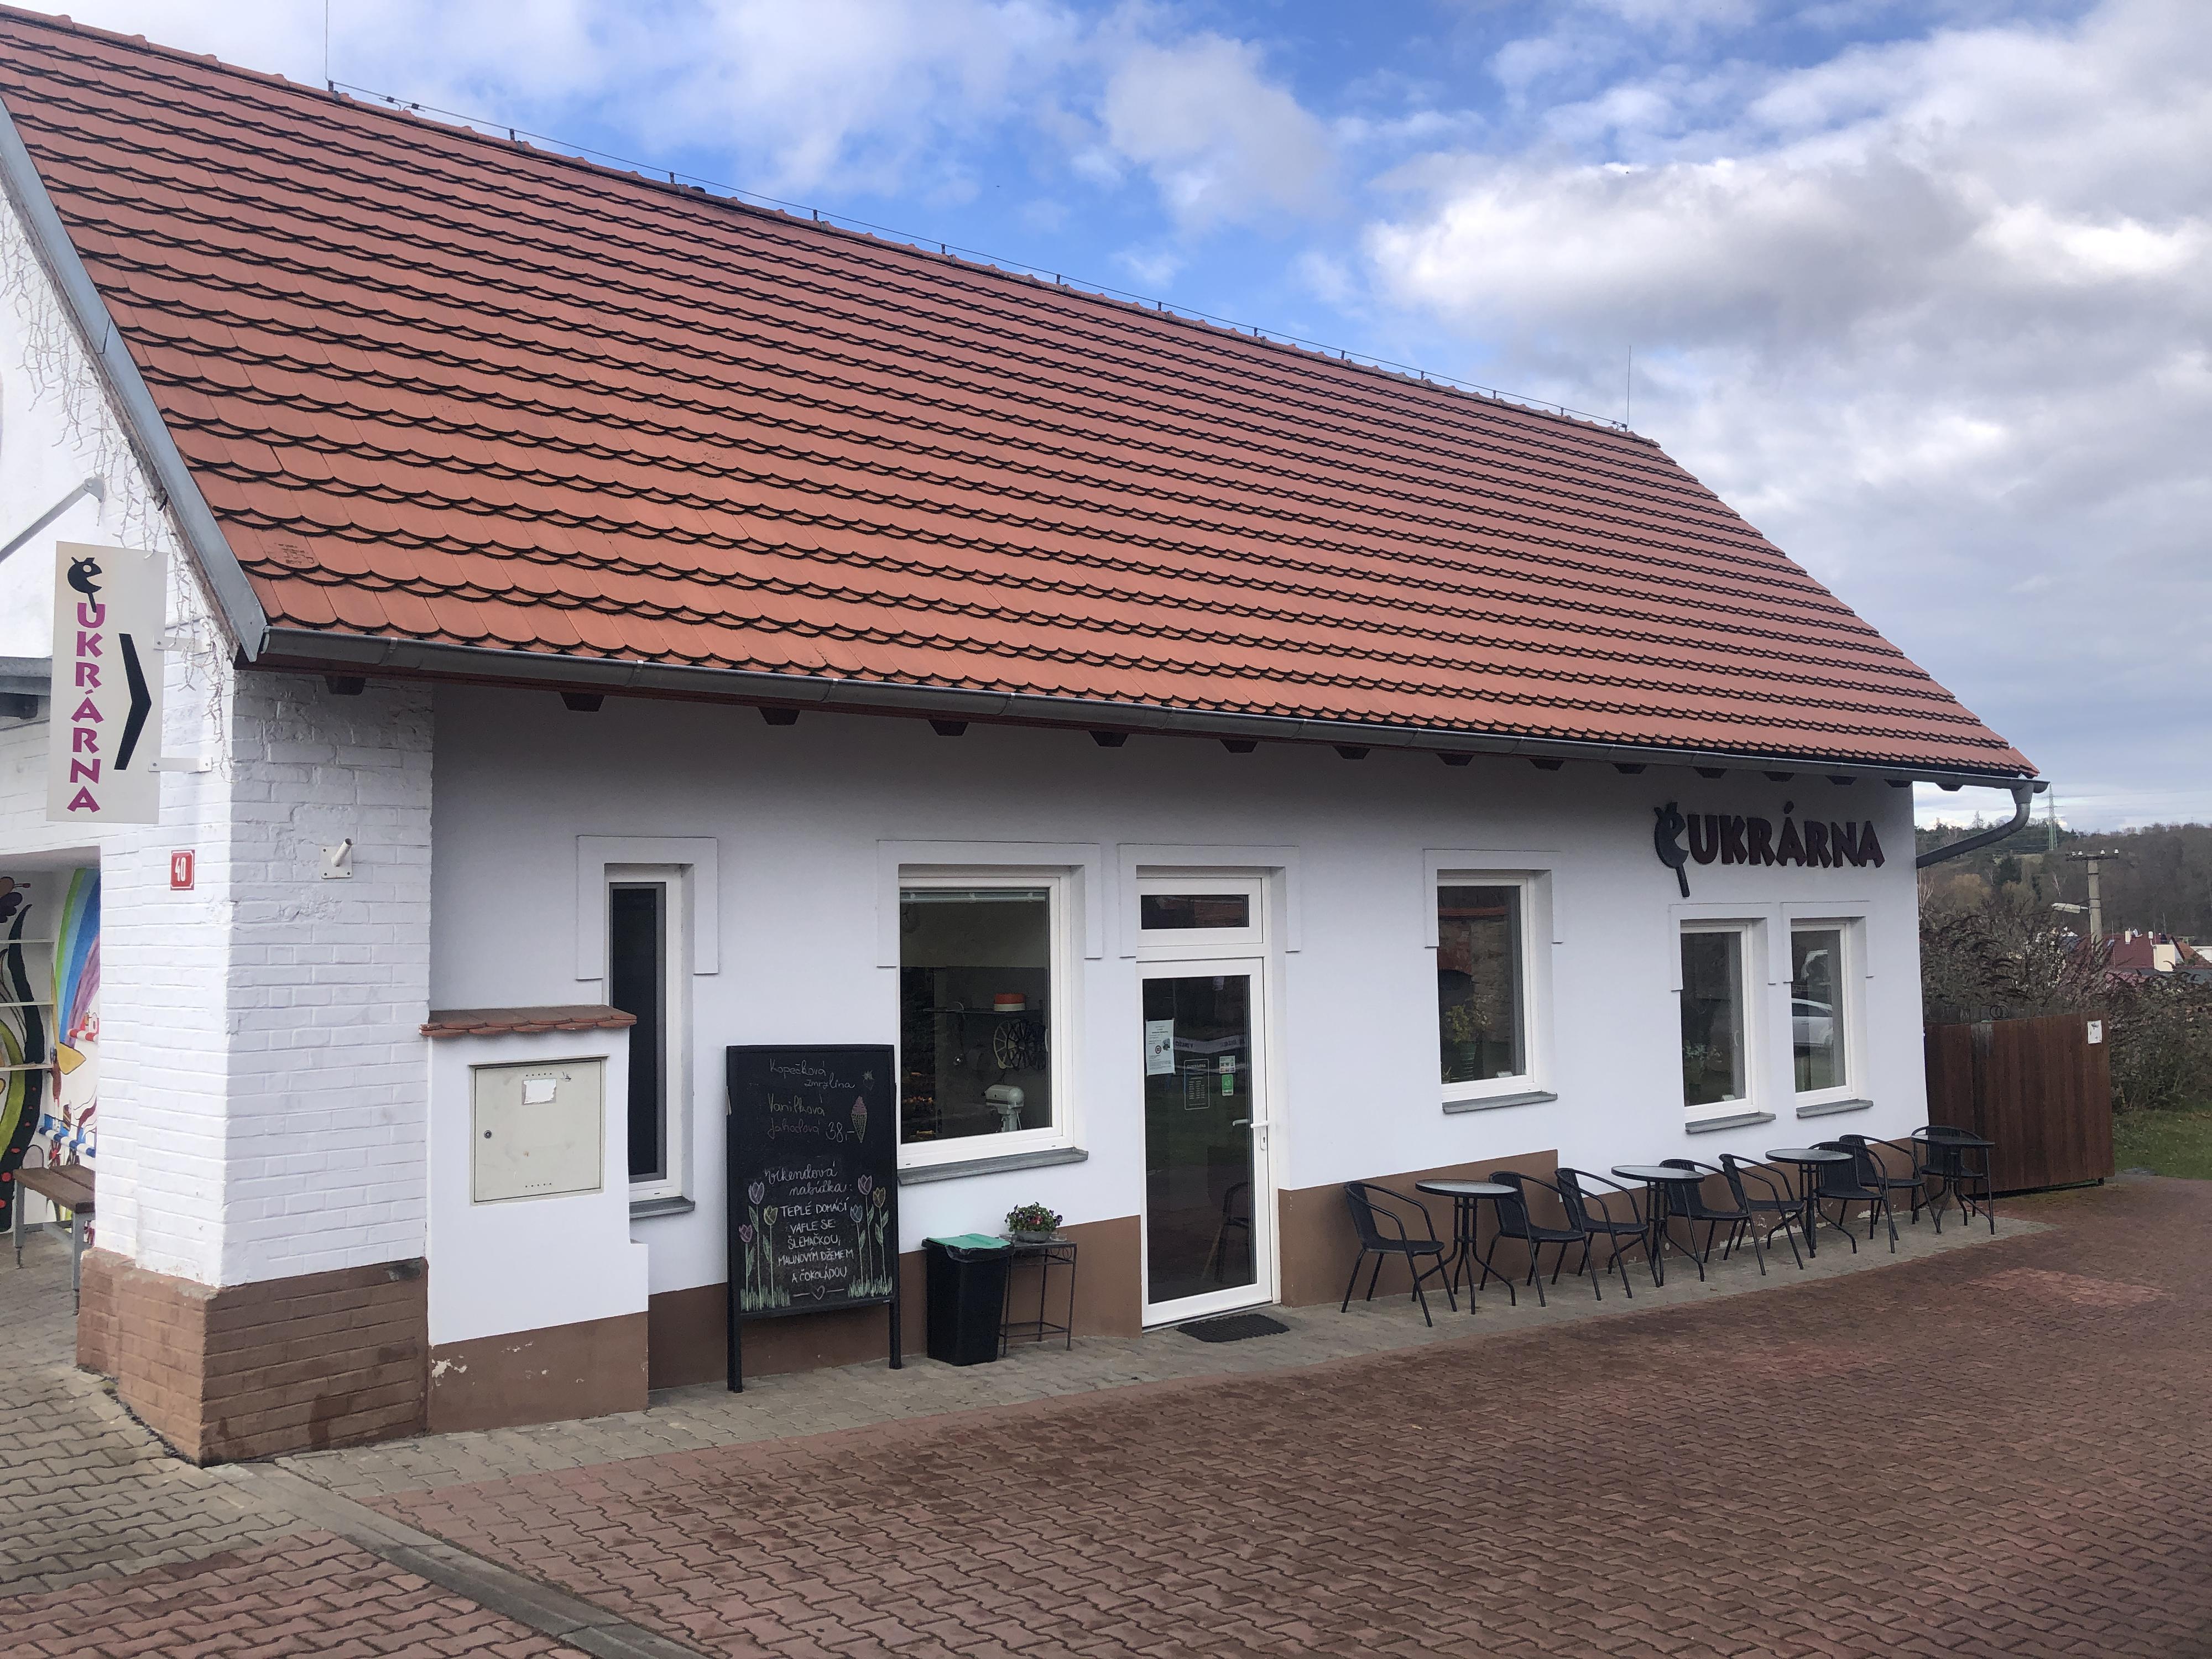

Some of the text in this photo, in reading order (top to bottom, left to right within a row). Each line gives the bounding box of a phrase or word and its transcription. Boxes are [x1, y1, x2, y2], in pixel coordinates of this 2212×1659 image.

[175, 857, 186, 882] 40
[780, 1197, 849, 1218] TEPLÉ DOMÁCÍ
[790, 1219, 836, 1234] VAFLE SE
[778, 1247, 854, 1266] MALINOVÝM DŽEMEM
[791, 1264, 847, 1283] A ČOKOLÁDOU
